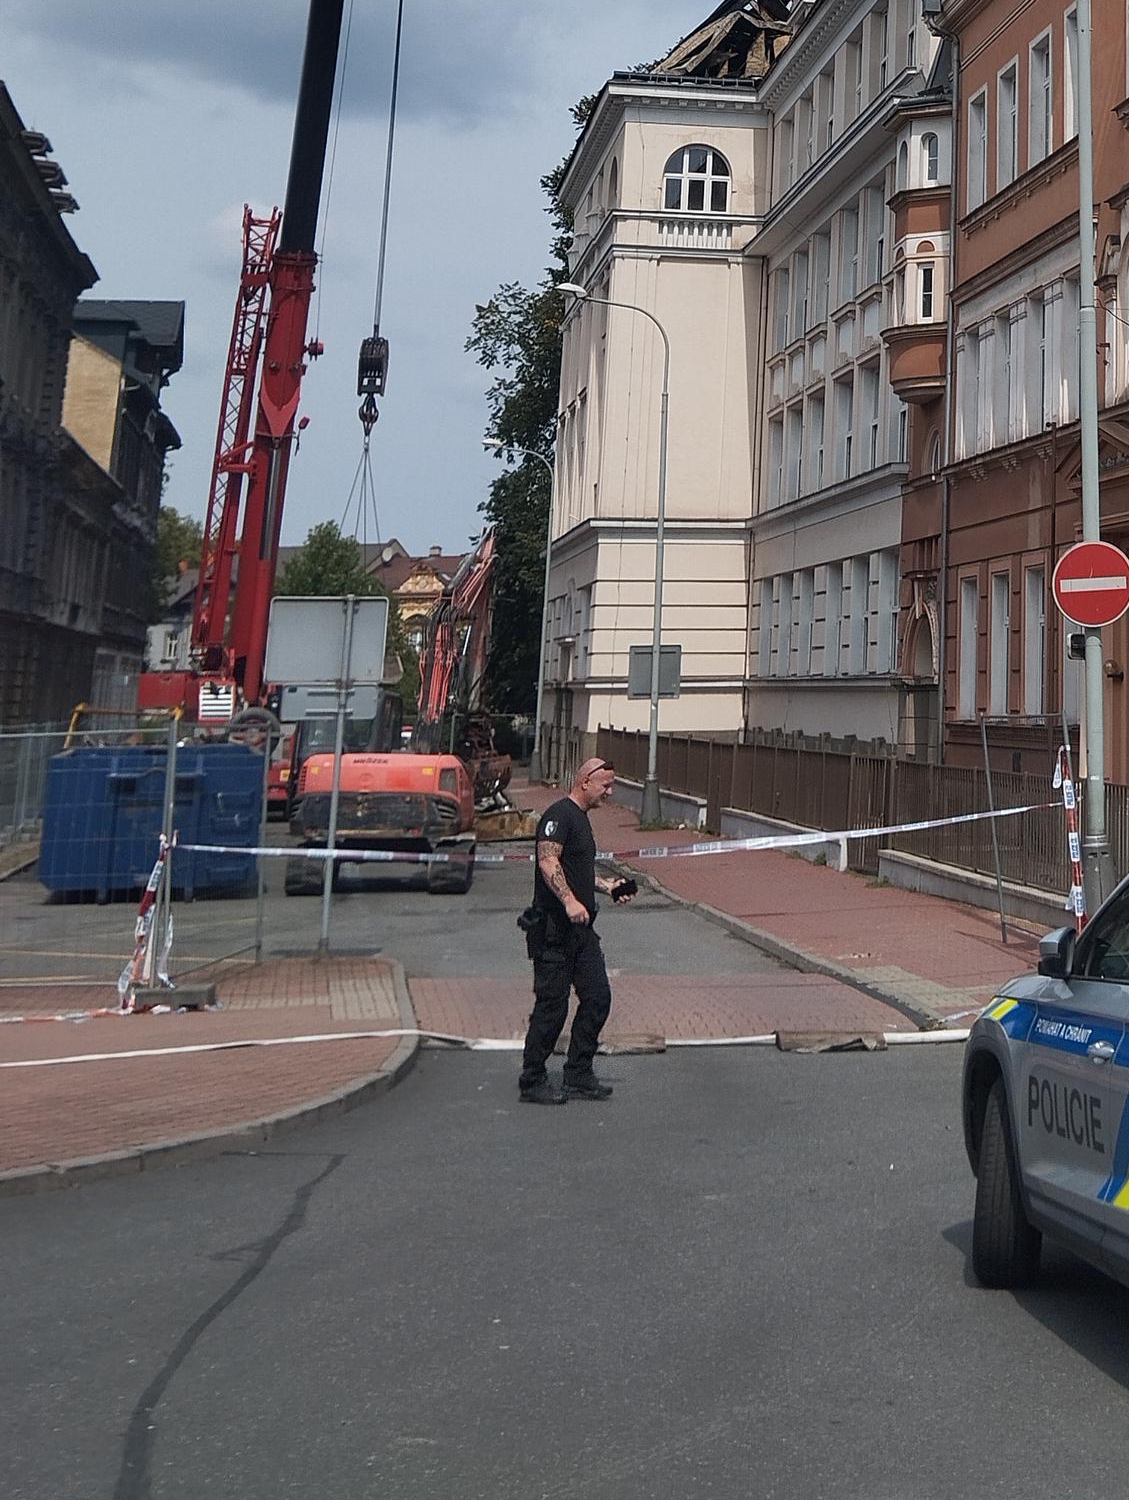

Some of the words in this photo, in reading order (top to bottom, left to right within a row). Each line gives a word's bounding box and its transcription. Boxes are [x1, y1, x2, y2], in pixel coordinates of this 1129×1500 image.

[1058, 1024, 1066, 1039] A
[1064, 1023, 1093, 1044] CHRÁNIT
[1028, 1075, 1105, 1154] POLICIE
